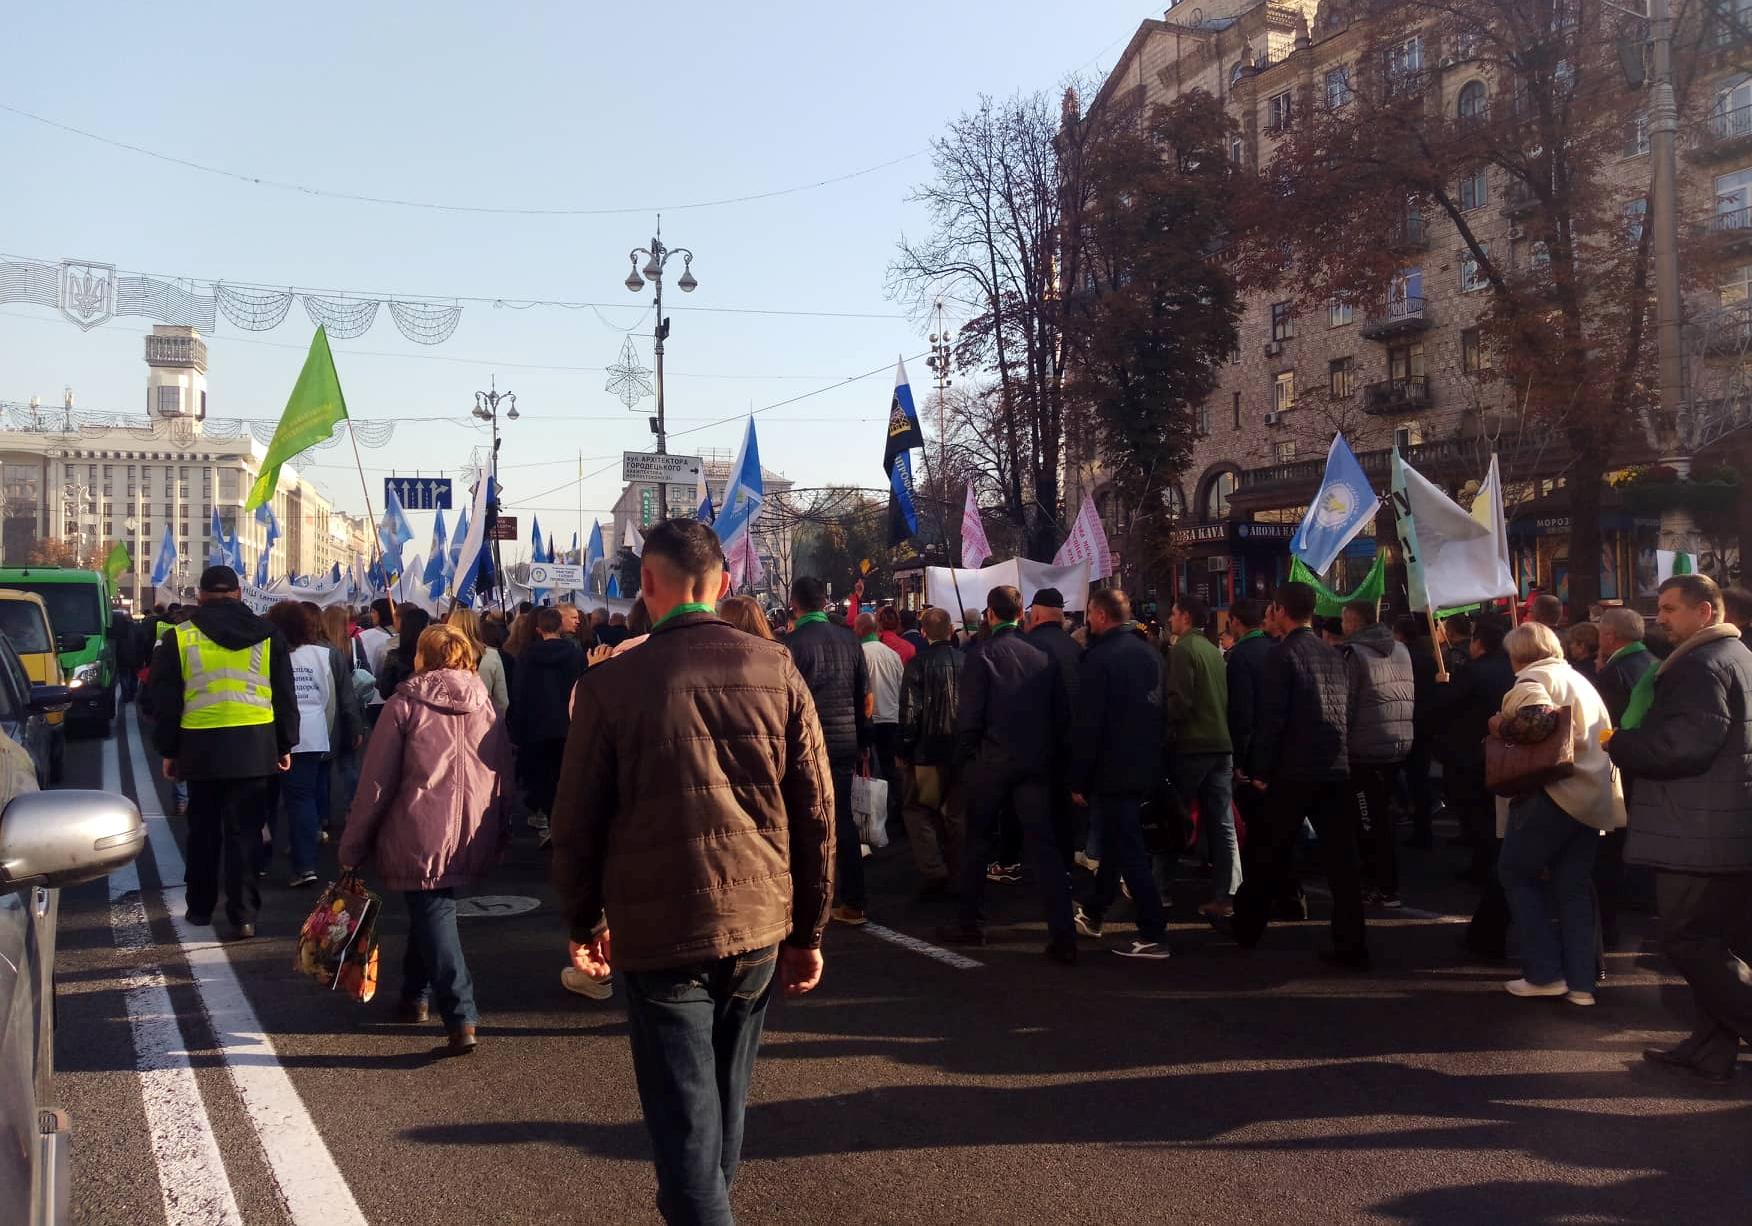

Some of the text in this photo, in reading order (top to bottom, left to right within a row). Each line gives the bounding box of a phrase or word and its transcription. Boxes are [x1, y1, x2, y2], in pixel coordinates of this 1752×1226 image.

[1198, 526, 1225, 540] KAVA
[1249, 526, 1297, 537] AROMA KA
